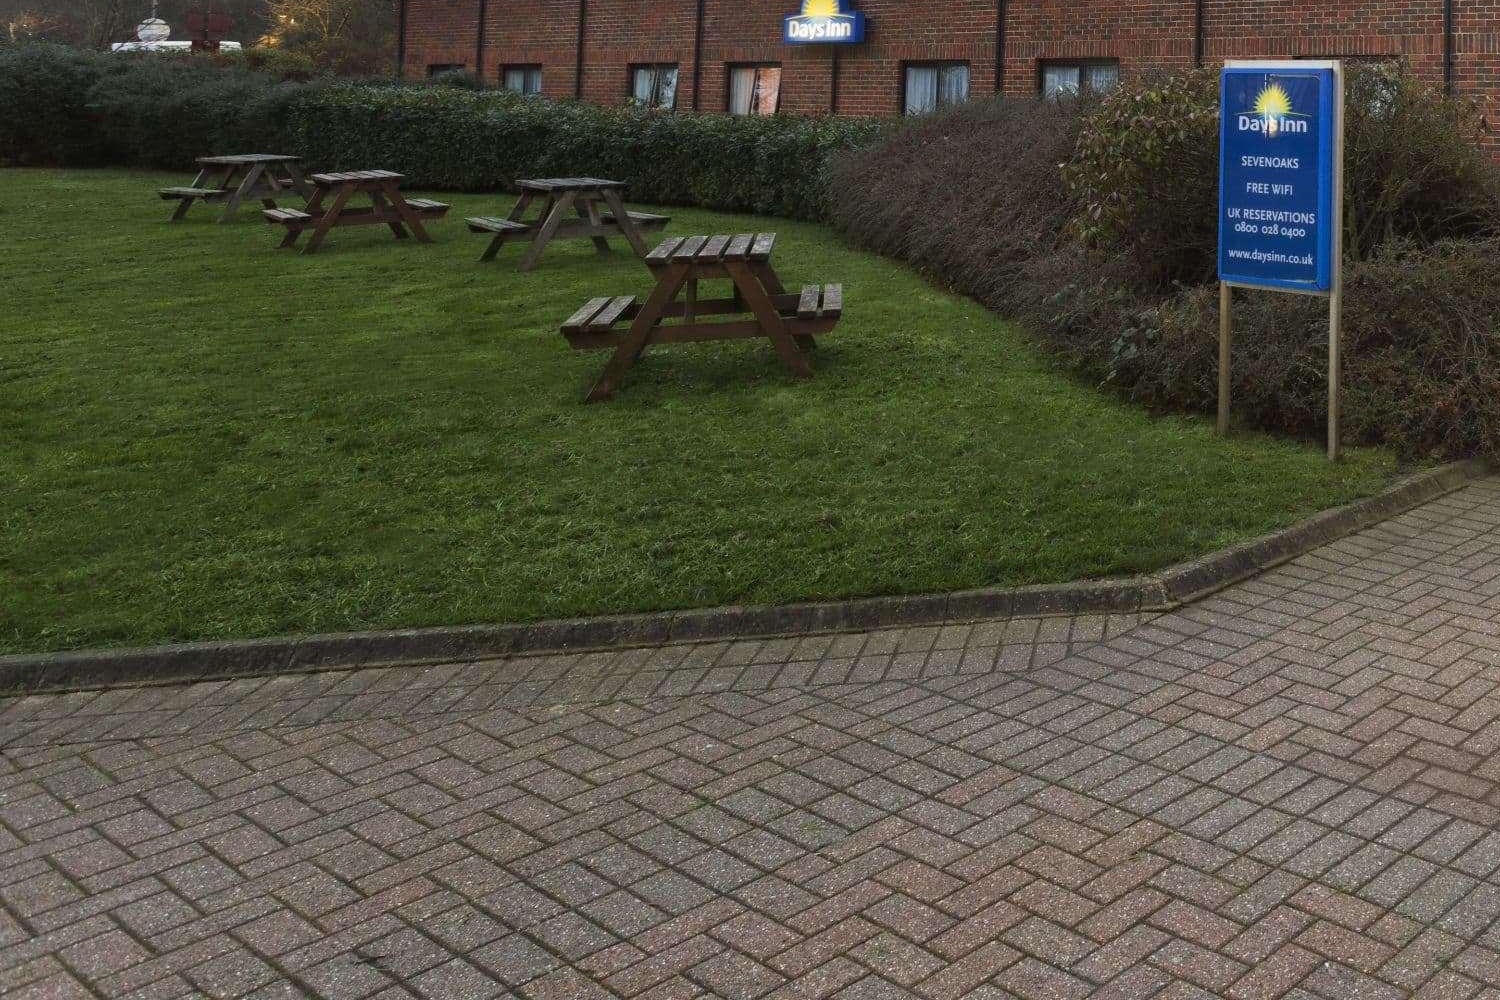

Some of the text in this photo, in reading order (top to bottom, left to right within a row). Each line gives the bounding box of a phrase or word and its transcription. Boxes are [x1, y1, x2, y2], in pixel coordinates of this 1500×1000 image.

[788, 20, 851, 40] Days Inn
[1238, 115, 1307, 135] Days Inn
[1241, 155, 1299, 169] SEVENOAKS
[1246, 182, 1293, 196] FREE WIFI
[1227, 207, 1316, 225] UK RESERVATIONS
[1234, 221, 1306, 240] 0800 028 0400
[1228, 248, 1314, 266] www.daysinn.co.uk
